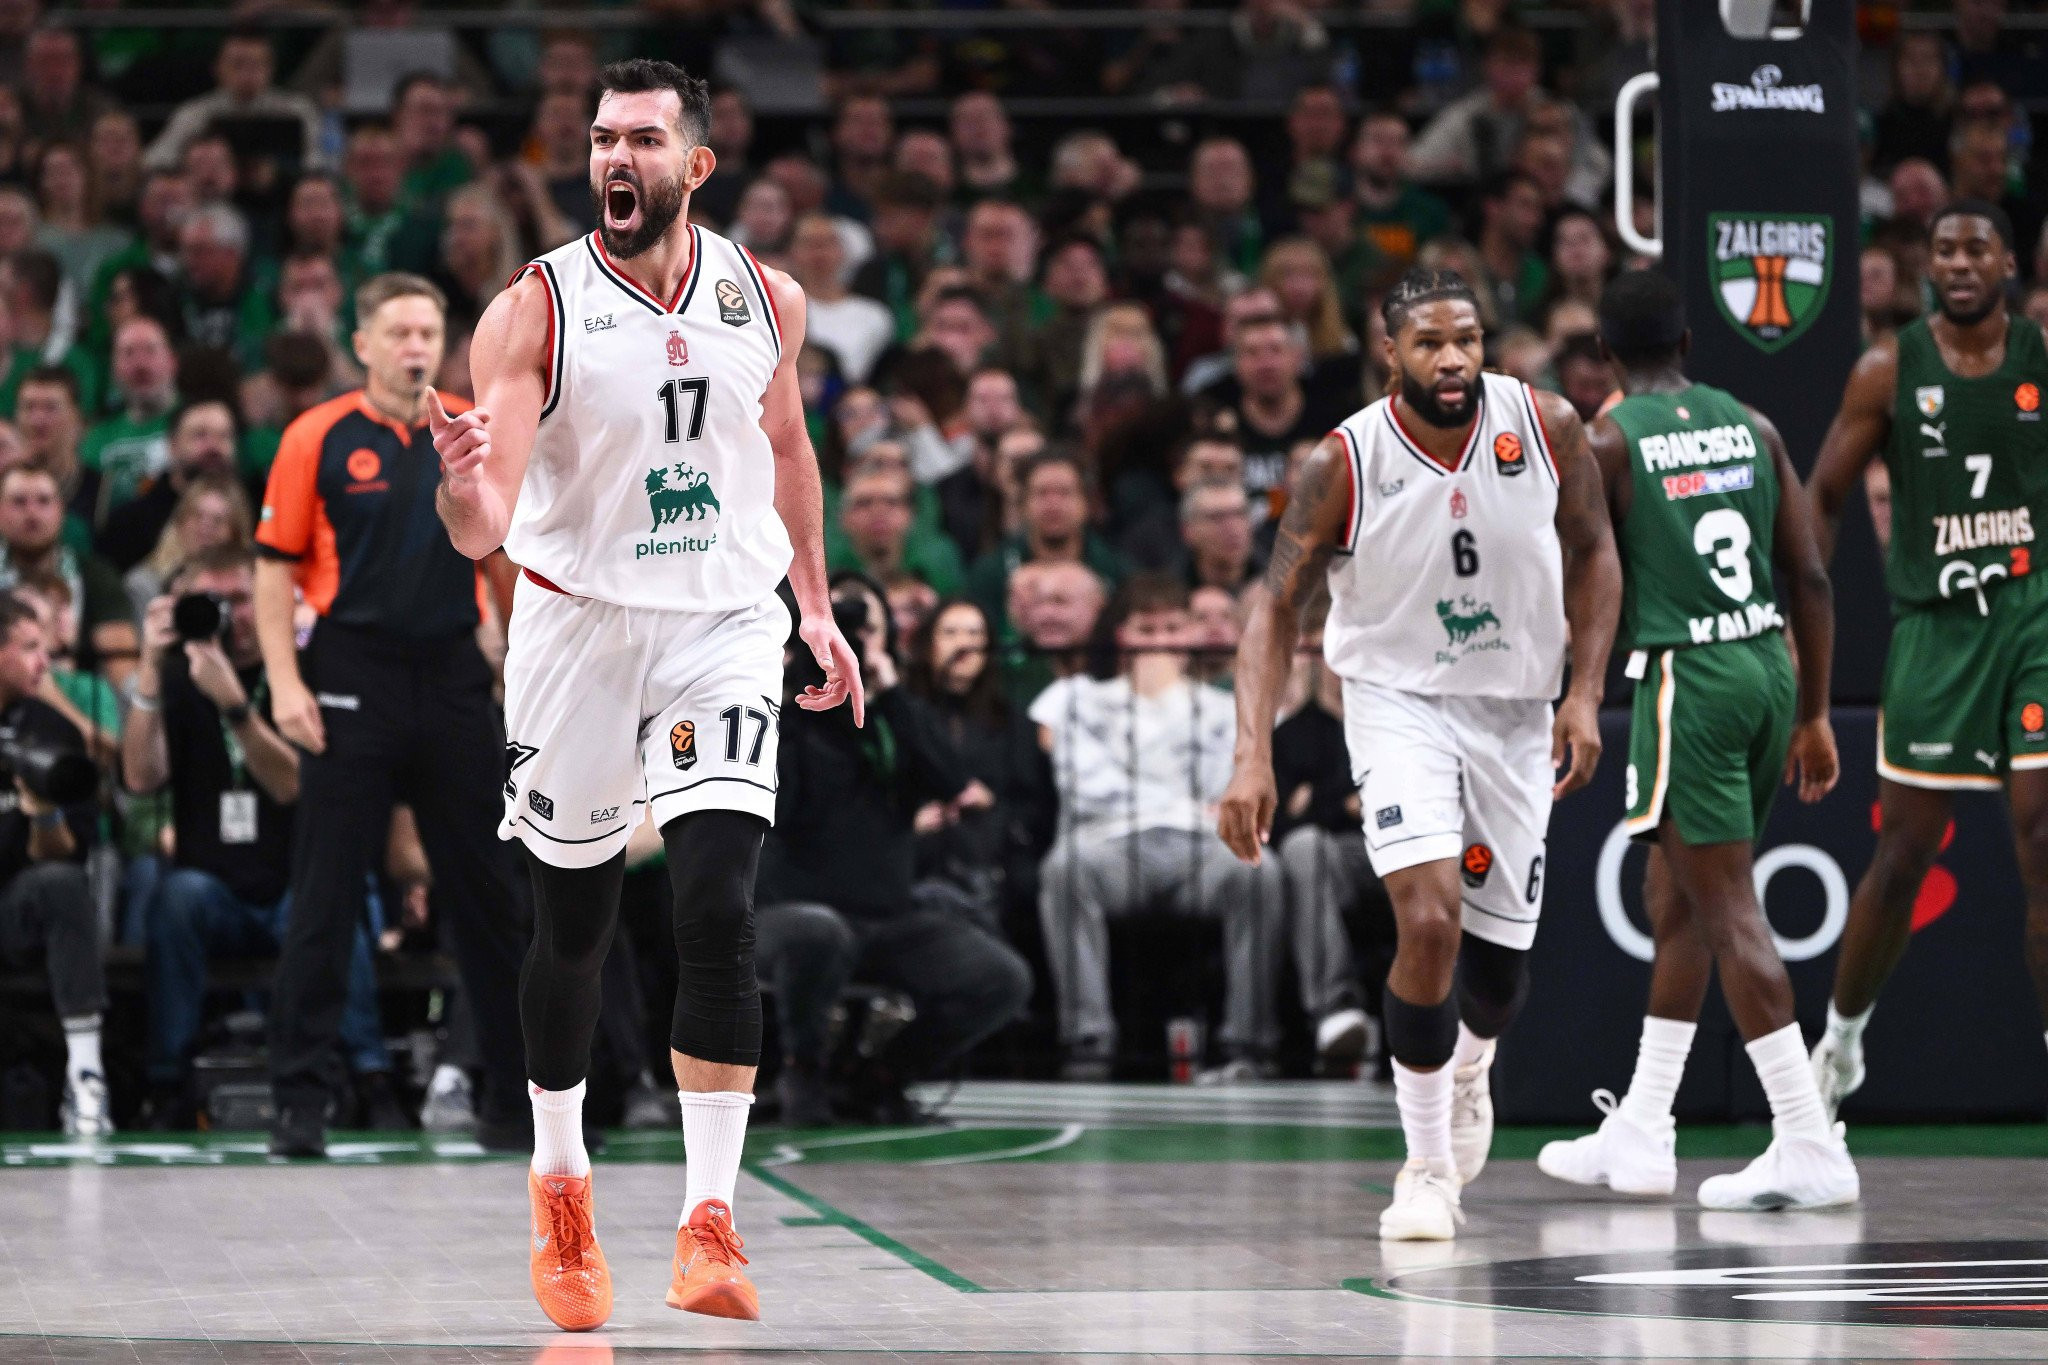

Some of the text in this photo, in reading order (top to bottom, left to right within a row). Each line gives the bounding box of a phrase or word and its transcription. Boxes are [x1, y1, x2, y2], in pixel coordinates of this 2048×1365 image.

[1711, 82, 1825, 113] SPALDING
[584, 313, 614, 331] EA7
[657, 376, 710, 443] 17
[1639, 424, 1757, 473] FRANCISCO
[1964, 454, 1993, 499] 7
[636, 533, 717, 560] plenitu
[1451, 529, 1480, 578] 6
[1694, 508, 1751, 601] 3
[1933, 506, 2035, 556] ZALGIRIS
[720, 704, 770, 767] 17
[531, 791, 551, 810] EA7
[591, 806, 620, 821] EA7
[1526, 856, 1543, 904] 6
